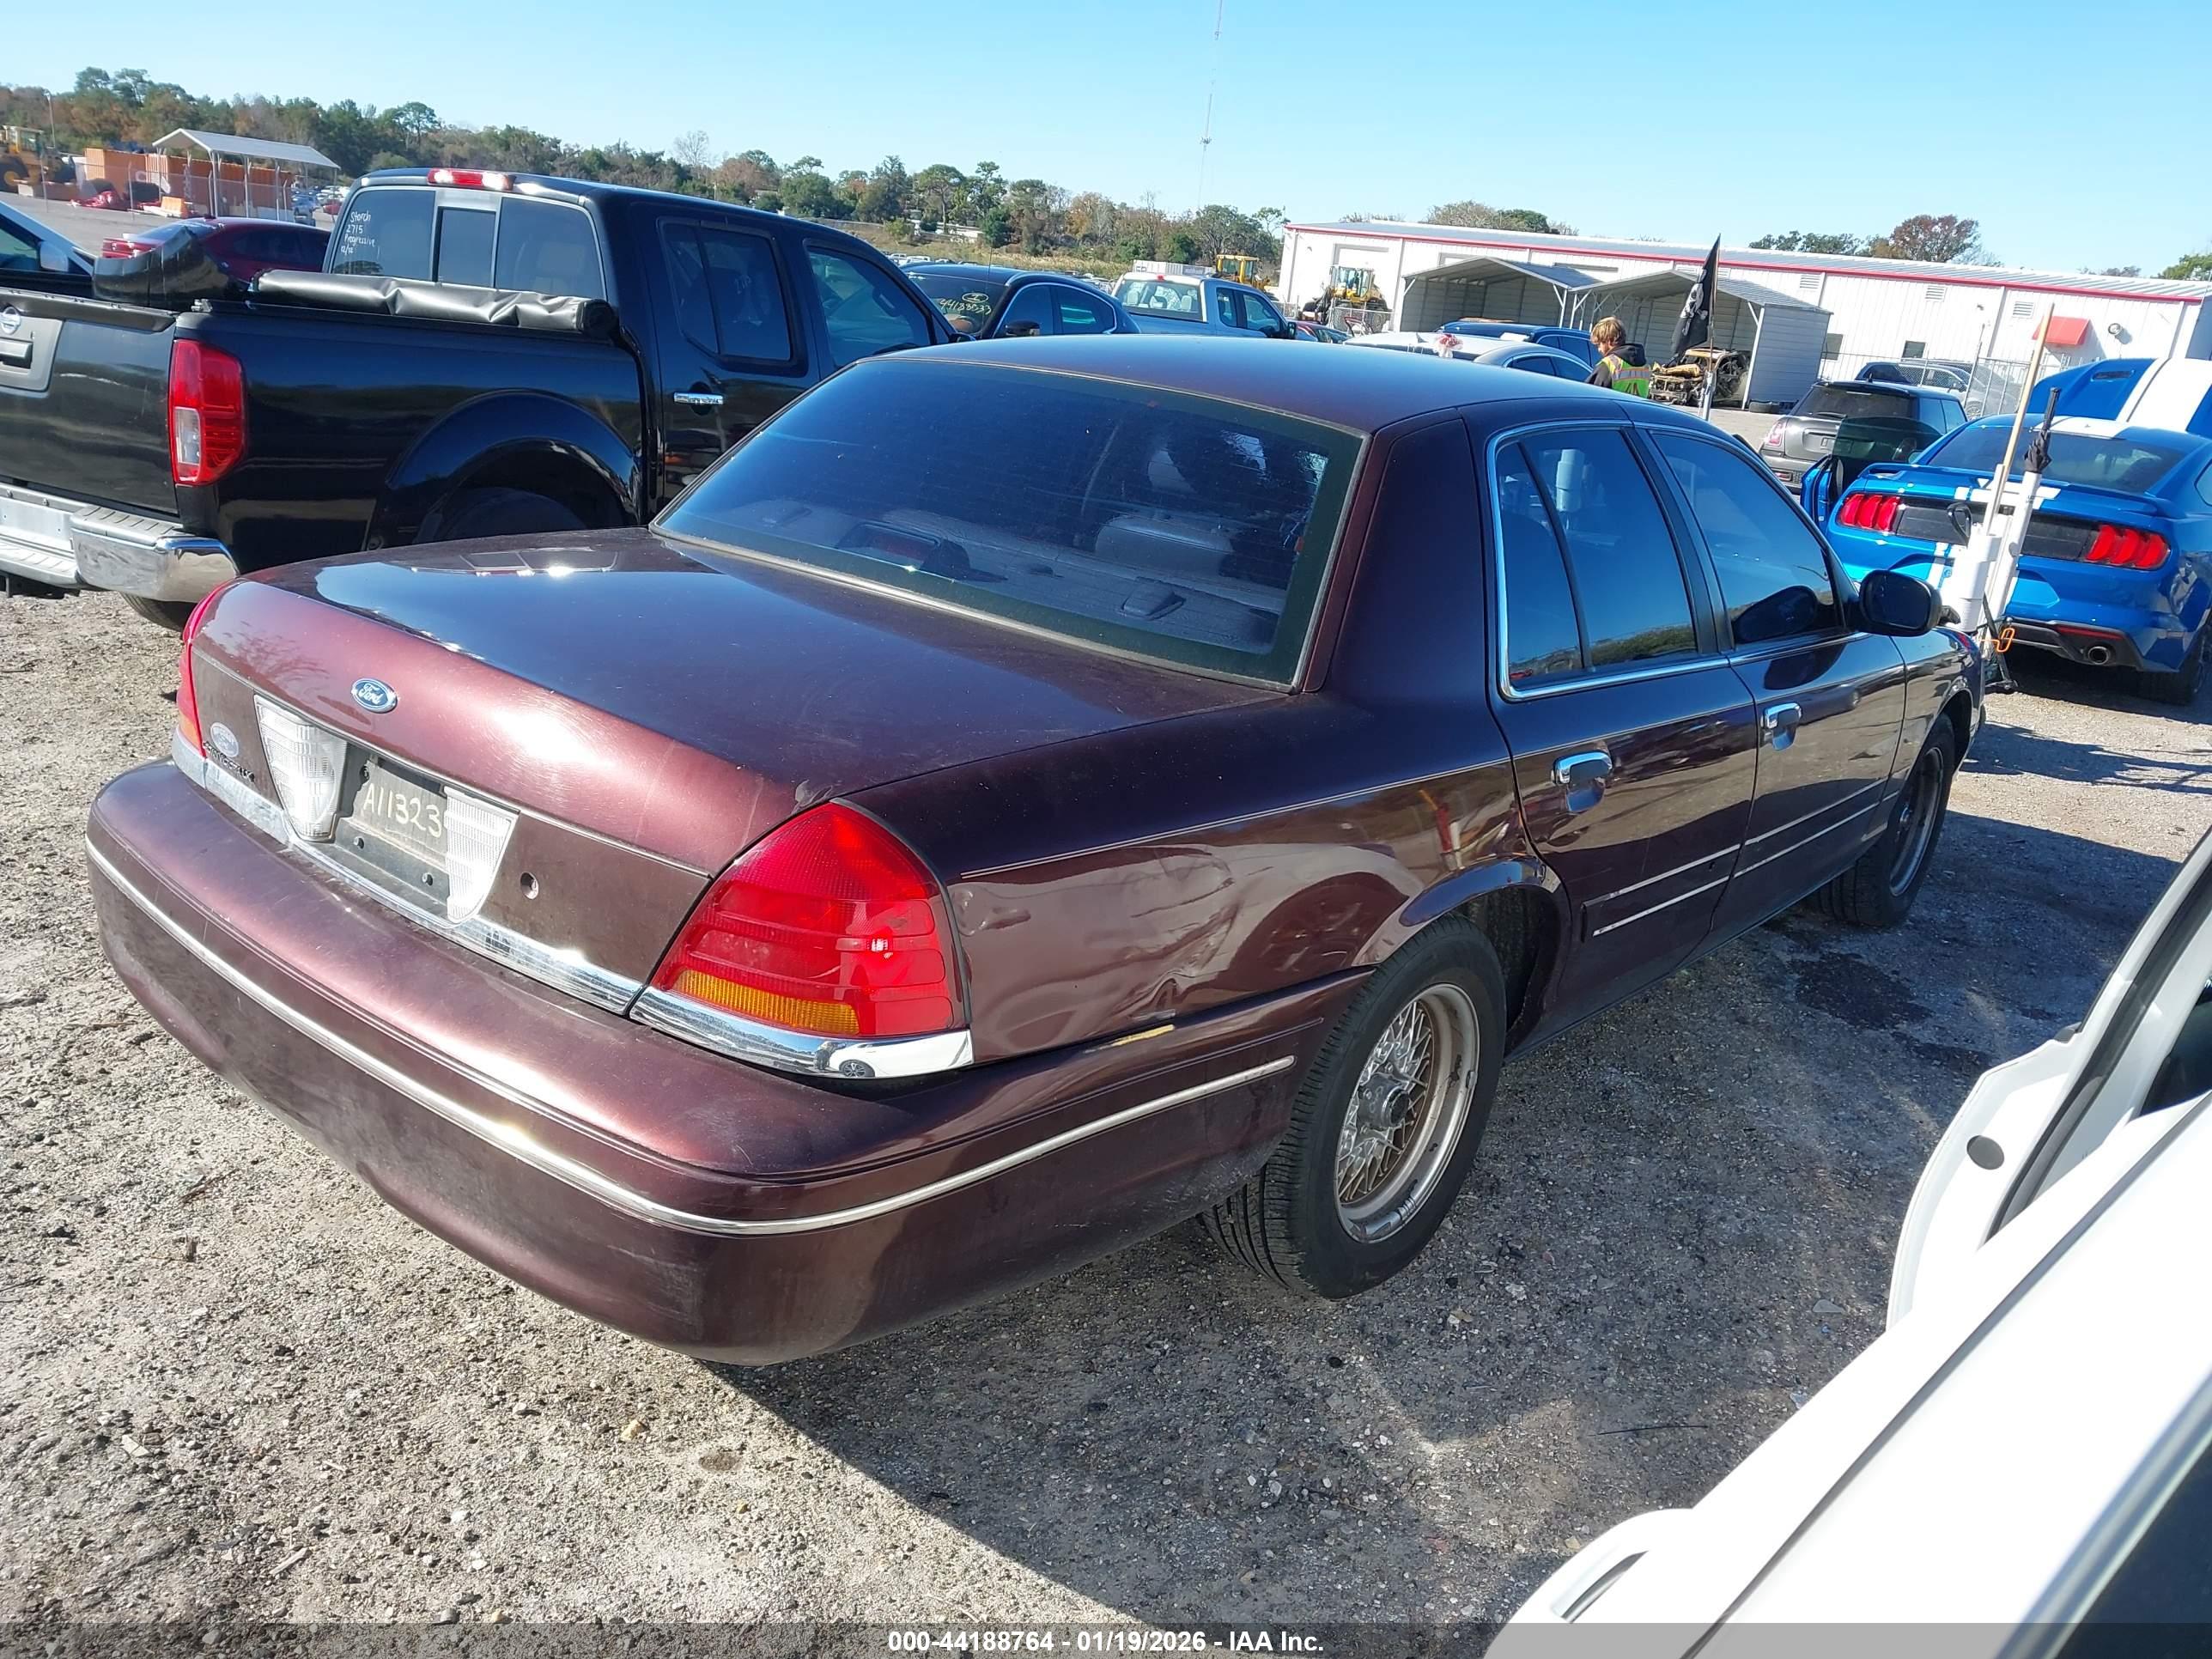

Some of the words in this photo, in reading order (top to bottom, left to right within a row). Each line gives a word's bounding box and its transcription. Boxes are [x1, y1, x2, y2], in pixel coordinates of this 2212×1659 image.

[346, 224, 363, 234] 2715
[358, 683, 385, 704] Ford
[363, 782, 442, 838] A11323
